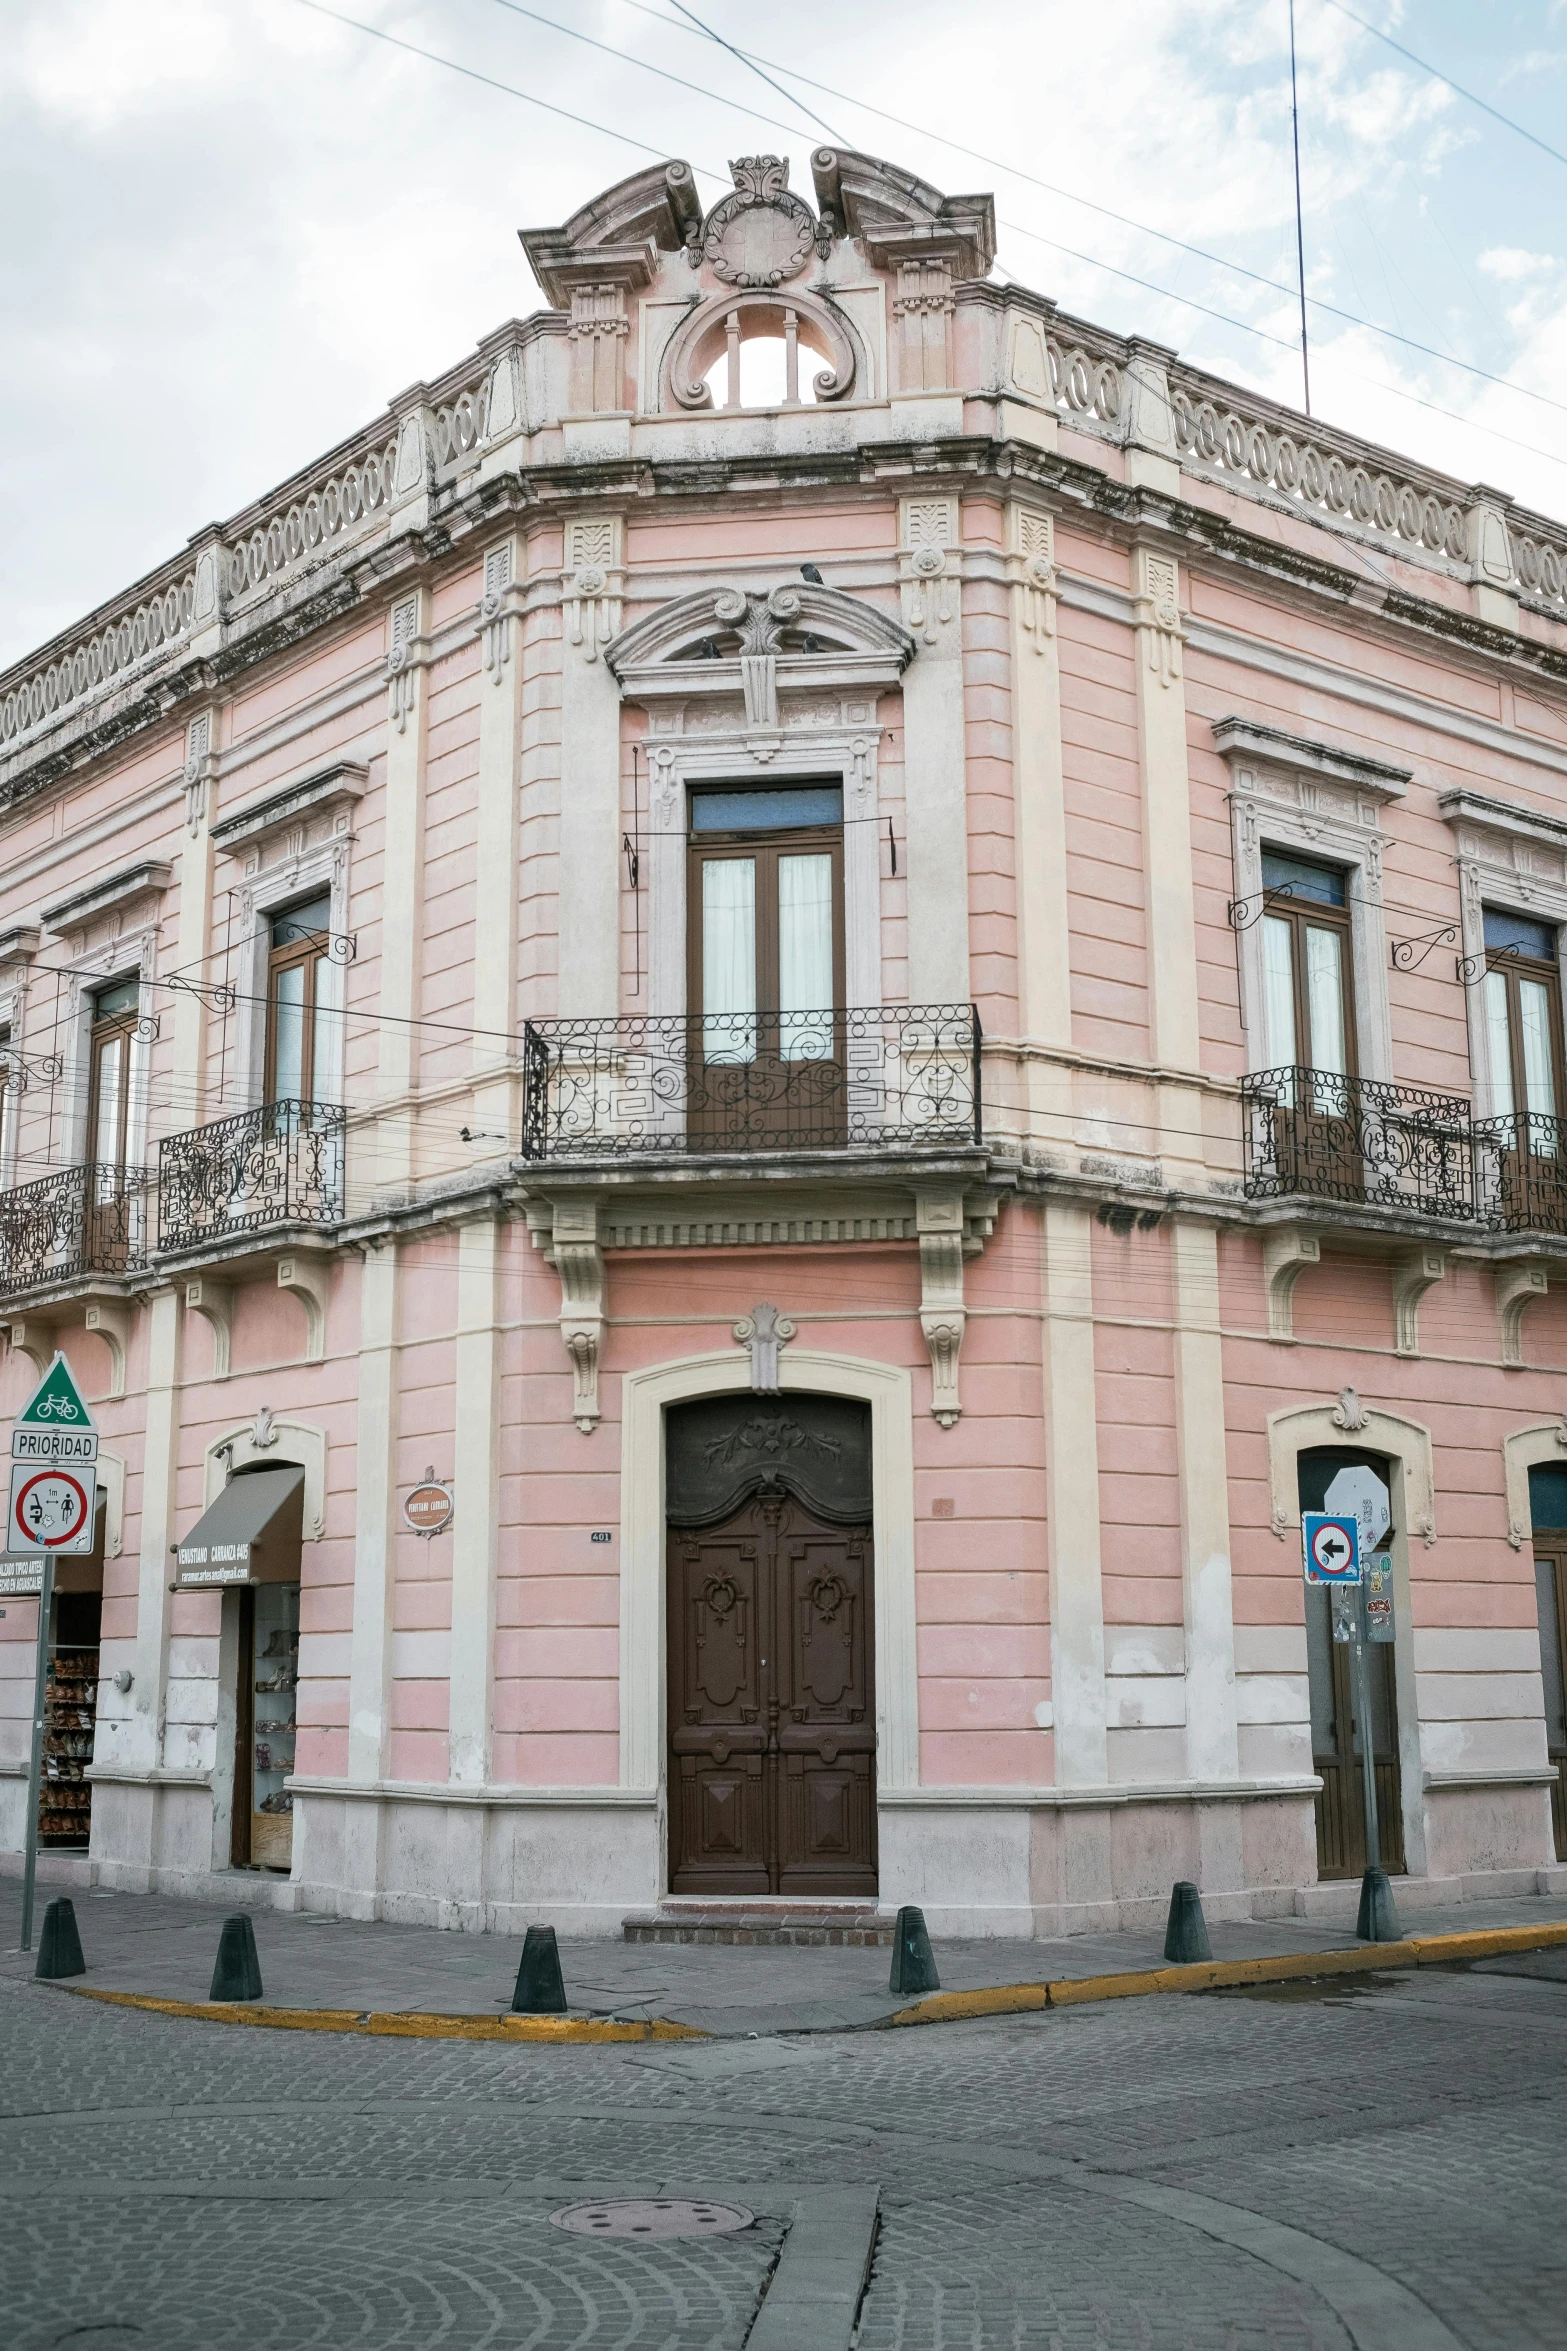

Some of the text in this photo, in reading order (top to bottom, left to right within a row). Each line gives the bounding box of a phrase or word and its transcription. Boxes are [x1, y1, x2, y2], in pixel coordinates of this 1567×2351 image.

[19, 1435, 92, 1456] PRIORIDAD
[48, 1488, 58, 1496] 1m
[592, 1533, 609, 1541] 401
[178, 1547, 208, 1564] VENUSTIANO
[211, 1545, 236, 1562] CARRANZA
